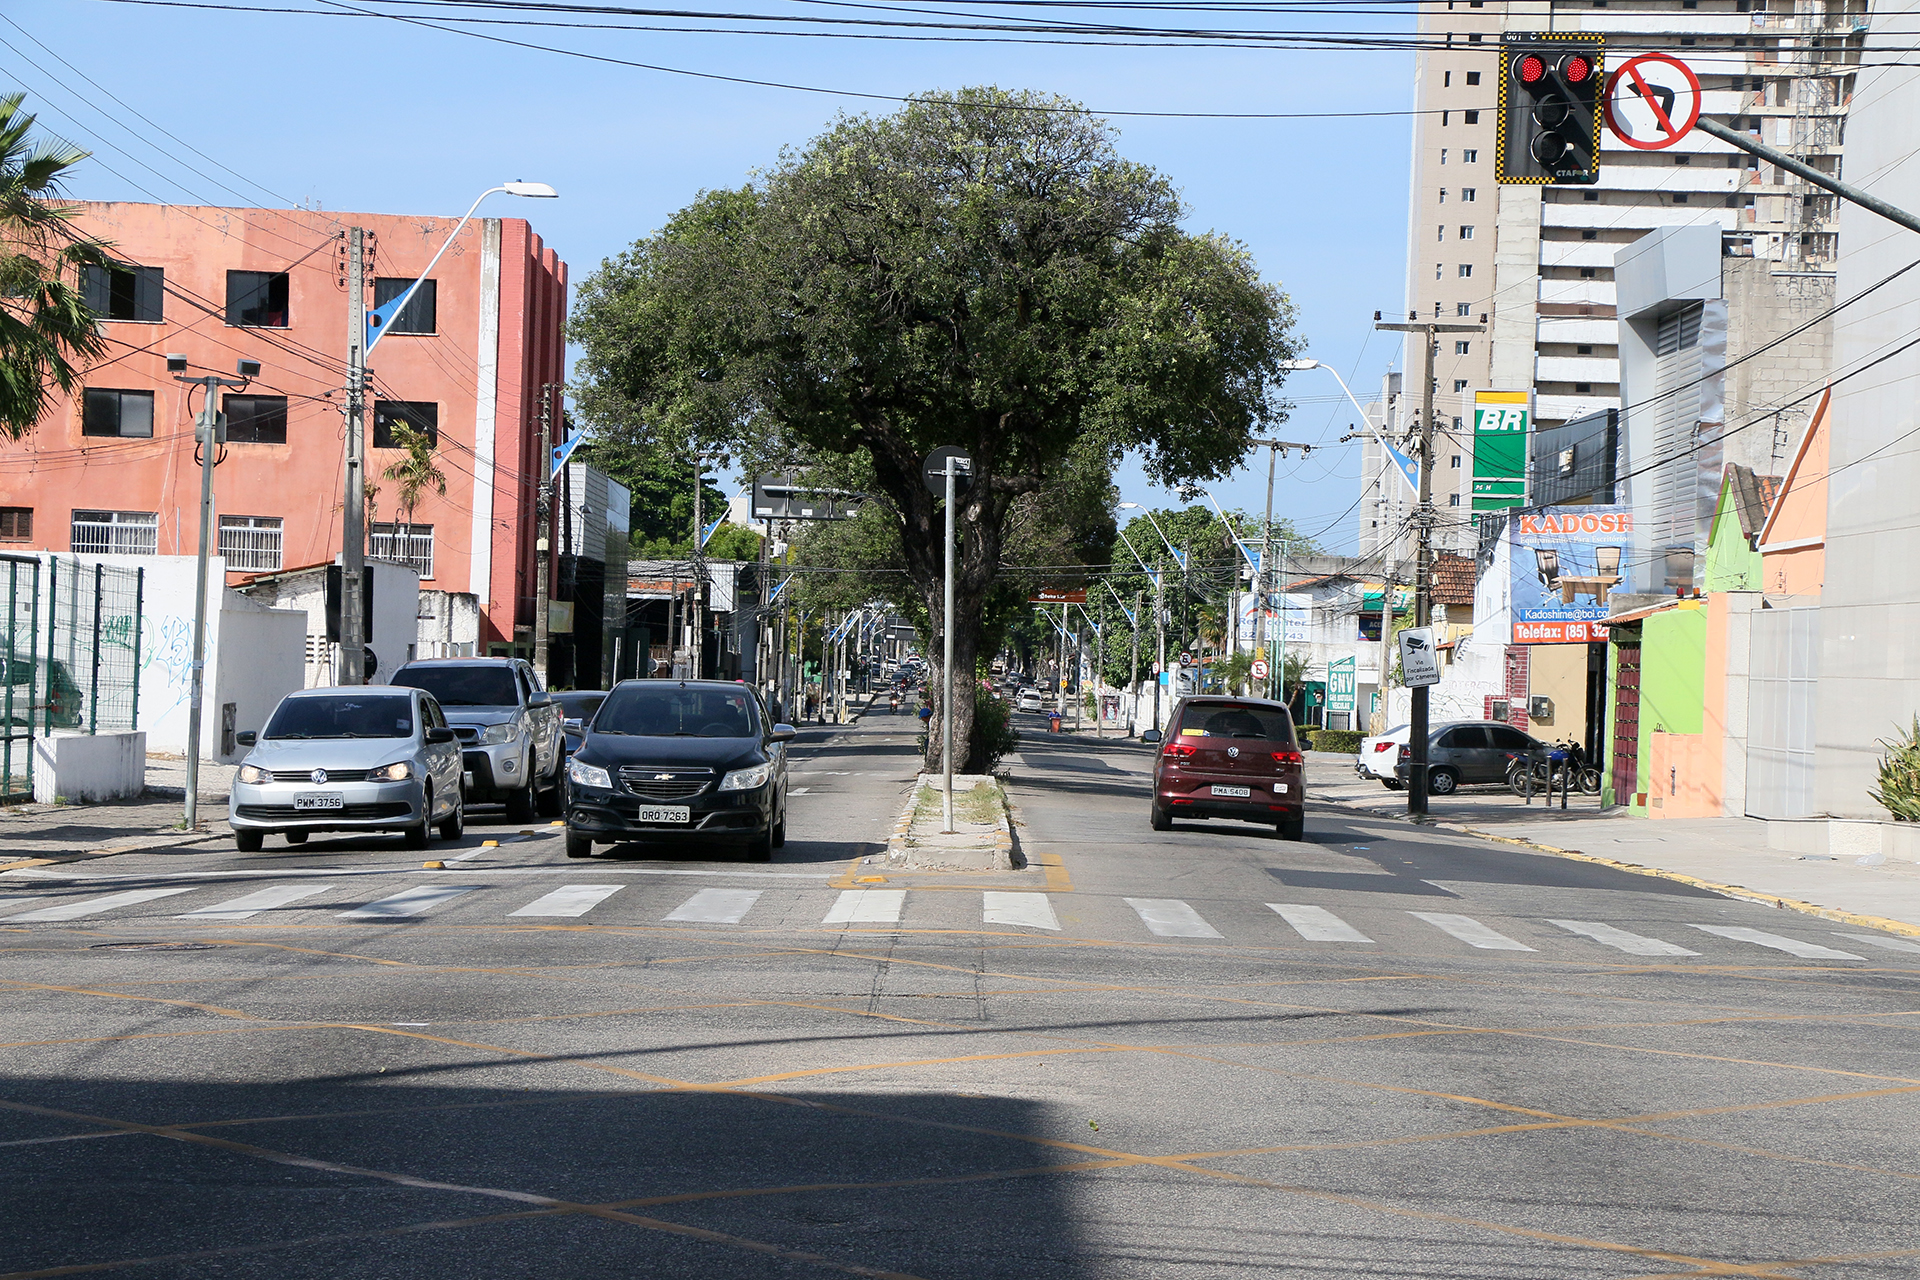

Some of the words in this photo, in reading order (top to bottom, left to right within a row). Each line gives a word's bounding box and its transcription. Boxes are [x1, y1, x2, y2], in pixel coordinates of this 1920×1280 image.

[1479, 408, 1522, 431] BR
[1573, 536, 1590, 544] Para
[1516, 624, 1561, 639] Telefax:
[1565, 624, 1587, 641] (85)
[1330, 672, 1354, 693] GNV
